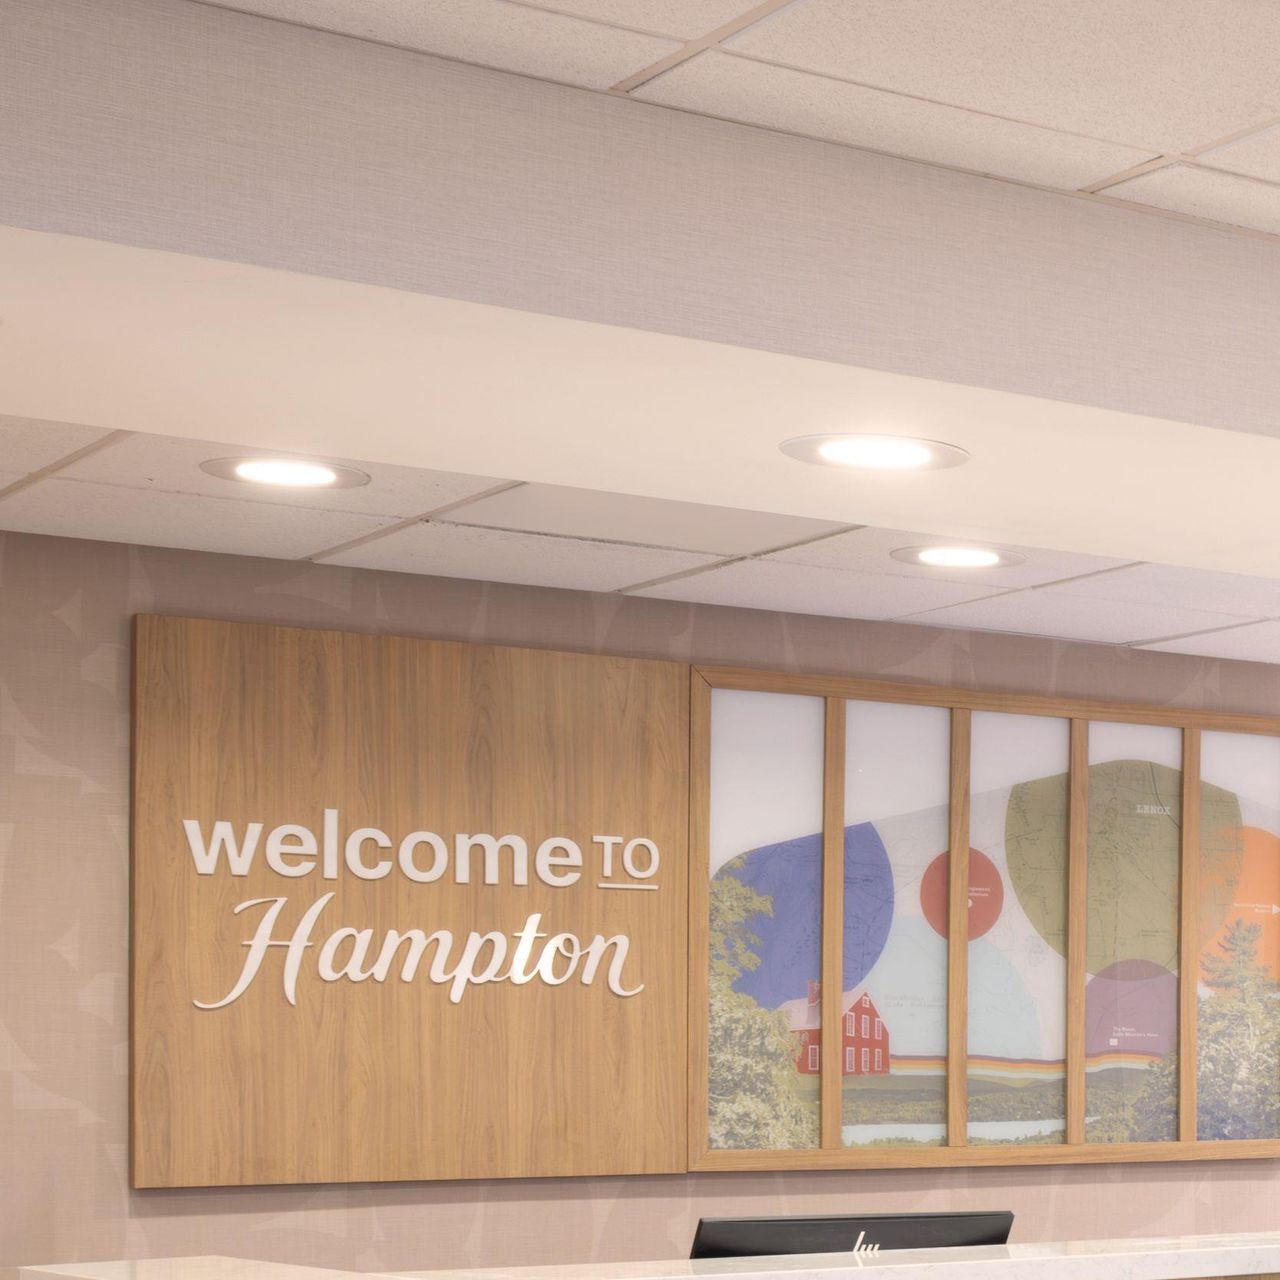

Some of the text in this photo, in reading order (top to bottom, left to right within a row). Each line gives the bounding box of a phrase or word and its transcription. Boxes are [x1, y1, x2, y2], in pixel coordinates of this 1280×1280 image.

[182, 808, 660, 887] welcome TO
[1135, 804, 1172, 815] LENOX
[192, 891, 645, 1009] Hampton
